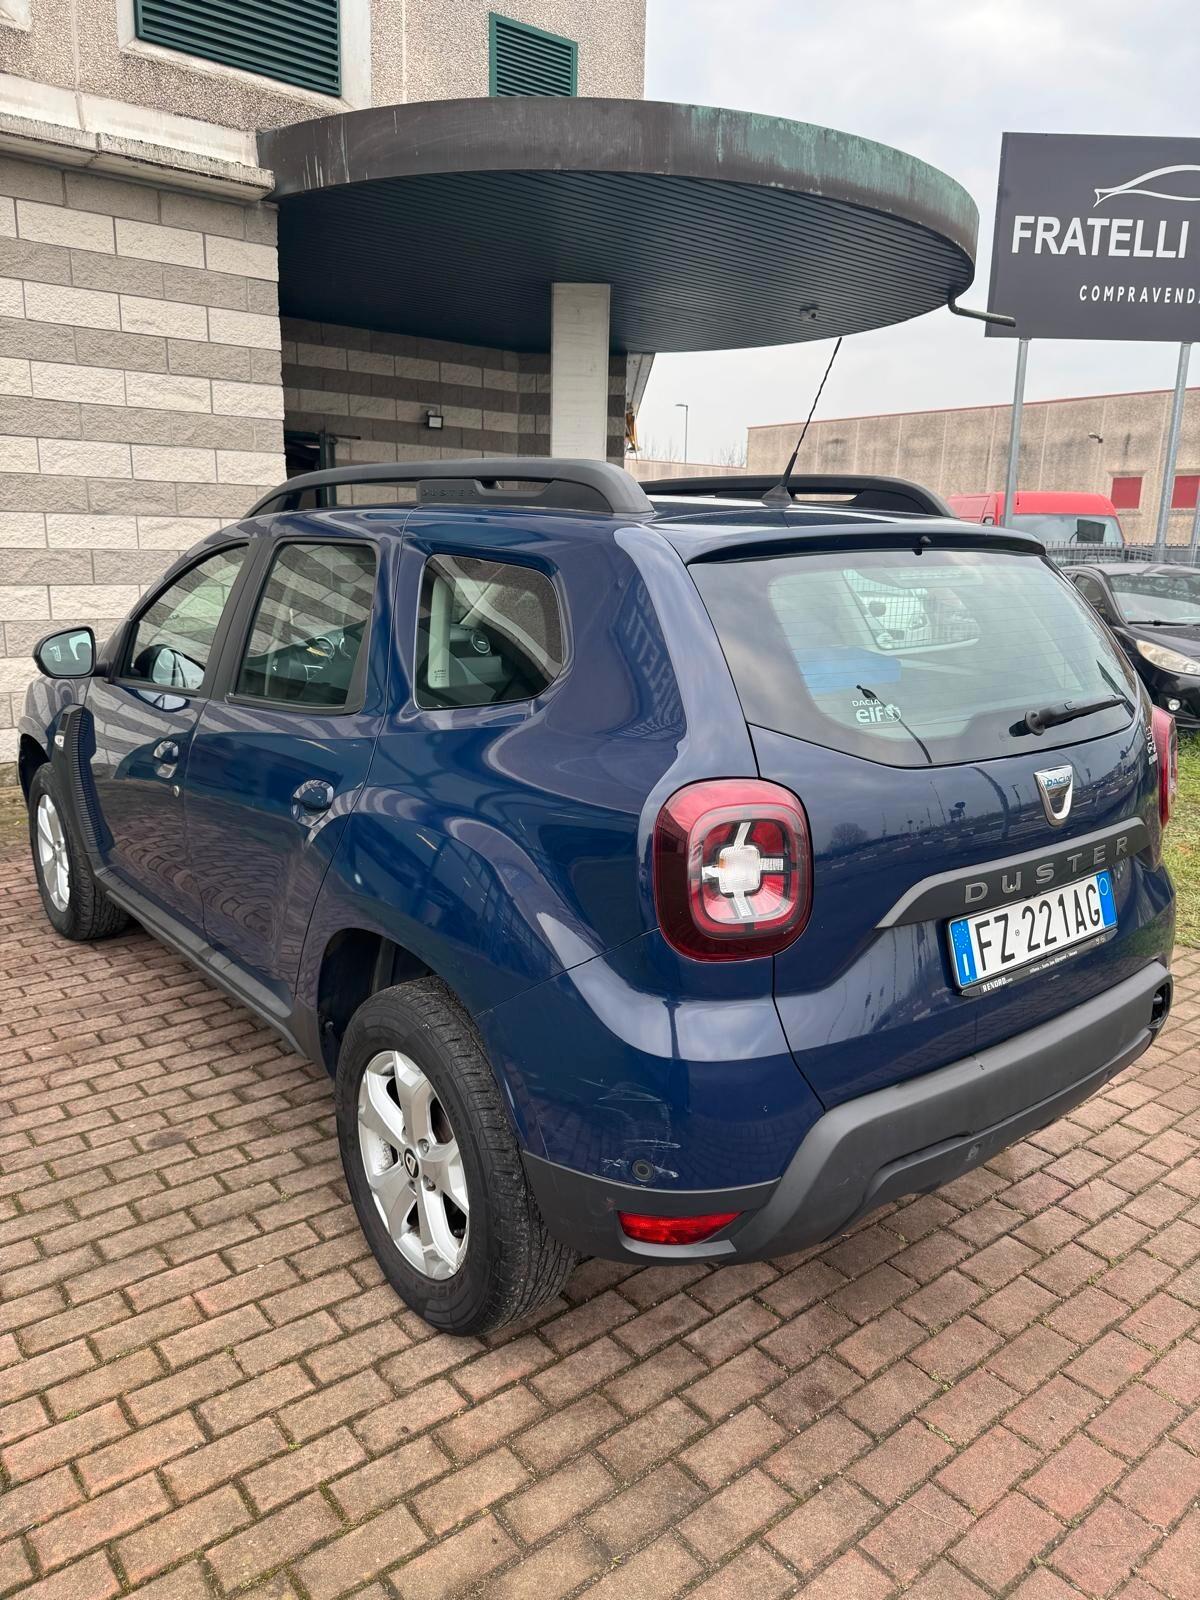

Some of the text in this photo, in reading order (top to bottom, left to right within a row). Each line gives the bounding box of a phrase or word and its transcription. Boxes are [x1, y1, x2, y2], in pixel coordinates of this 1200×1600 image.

[1011, 215, 1189, 259] FRATELLI
[1079, 285, 1200, 304] COMPRAVEND
[852, 699, 881, 707] DACIA
[856, 706, 884, 722] elf
[965, 836, 1128, 904] DUSTER
[974, 883, 1101, 971] FZ 221AG
